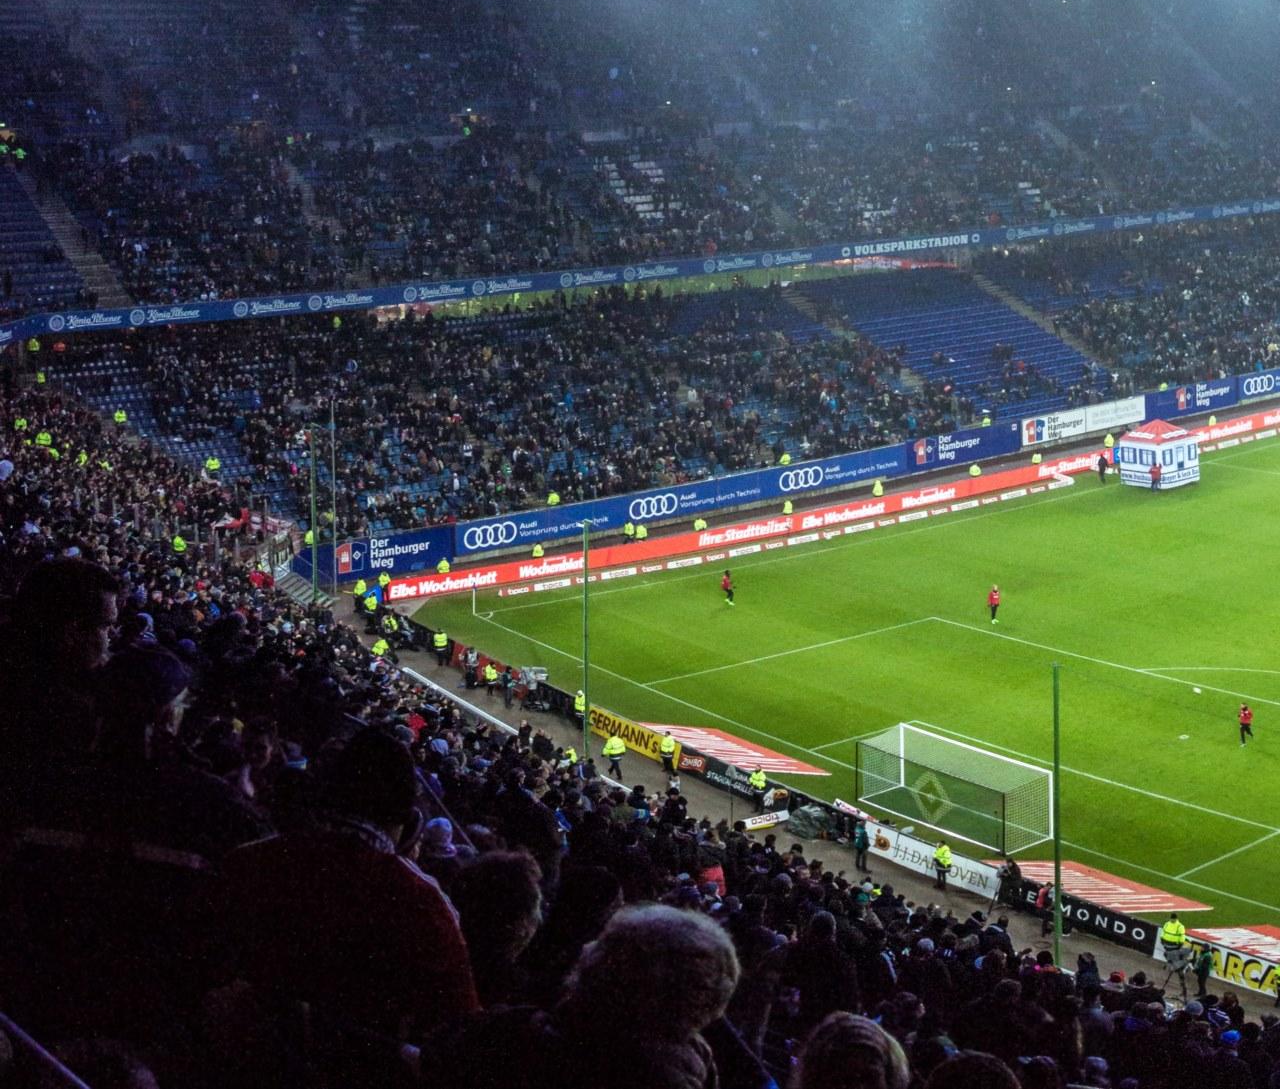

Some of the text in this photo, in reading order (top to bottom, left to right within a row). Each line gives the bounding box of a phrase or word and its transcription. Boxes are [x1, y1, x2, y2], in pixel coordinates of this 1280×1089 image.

[854, 234, 968, 256] VOLKSPARKSTADION
[1047, 417, 1084, 431] Hamburger
[1048, 416, 1059, 426] Der
[939, 435, 952, 444] Der
[1048, 429, 1063, 439] Weg
[938, 437, 981, 452] Hamburger
[939, 450, 955, 461] Weg
[825, 464, 840, 474] Audi
[680, 493, 696, 502] Audi
[680, 495, 715, 509] Vorsprung
[715, 492, 735, 502] durch
[902, 488, 956, 508] Wochenblatt
[824, 502, 885, 524] Wochenblatt
[519, 520, 538, 530] Audi
[519, 525, 558, 538] Vorsprung
[369, 538, 390, 549] Der
[699, 531, 724, 547] Ihre
[370, 541, 430, 559] Hamburger
[370, 557, 394, 569] Weg
[389, 571, 497, 599] Elbe Wochenblatt
